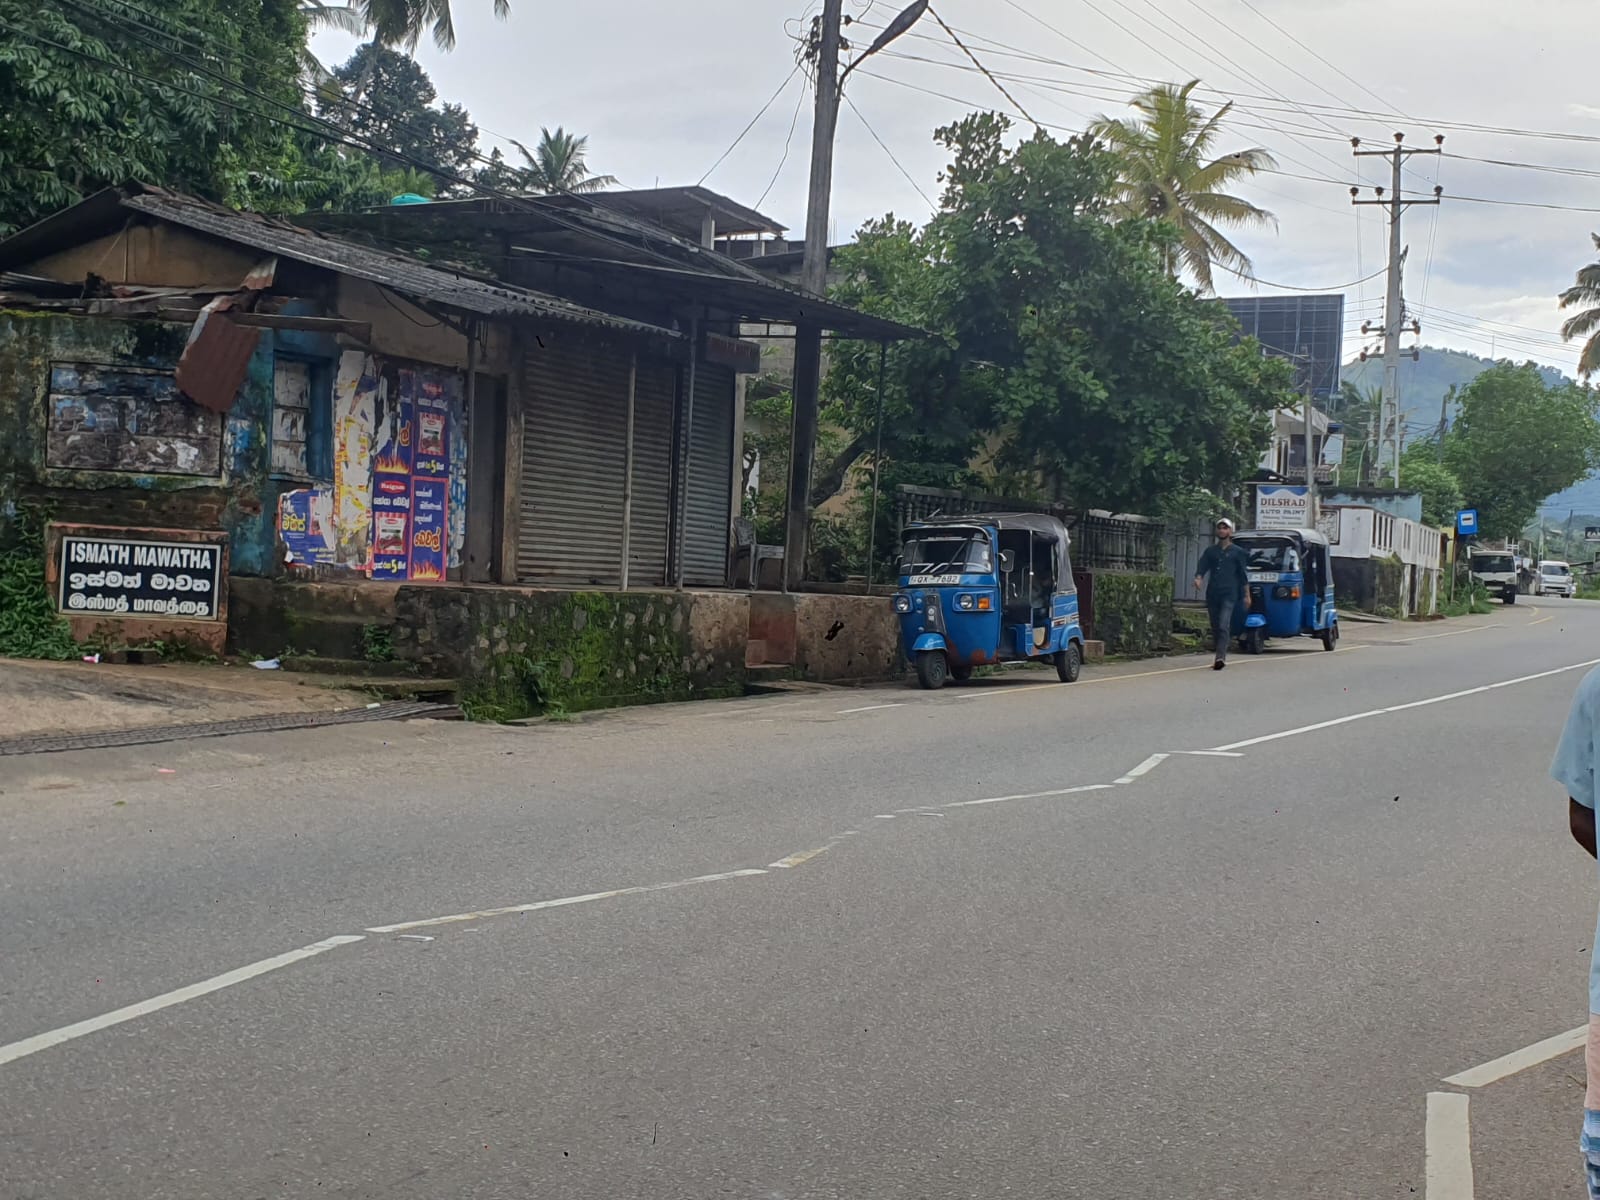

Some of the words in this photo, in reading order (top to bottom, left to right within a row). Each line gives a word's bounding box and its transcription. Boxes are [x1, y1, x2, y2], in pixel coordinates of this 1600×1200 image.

[1260, 498, 1306, 507] DILSHAD
[70, 542, 130, 565] ISMATH
[134, 546, 211, 569] MAWATHA
[391, 558, 398, 574] 5
[69, 570, 142, 590] ඉස්මත්
[150, 573, 211, 592] මාවත
[68, 592, 130, 614] இஸ்மத்
[133, 596, 209, 616] மாவத்தை
